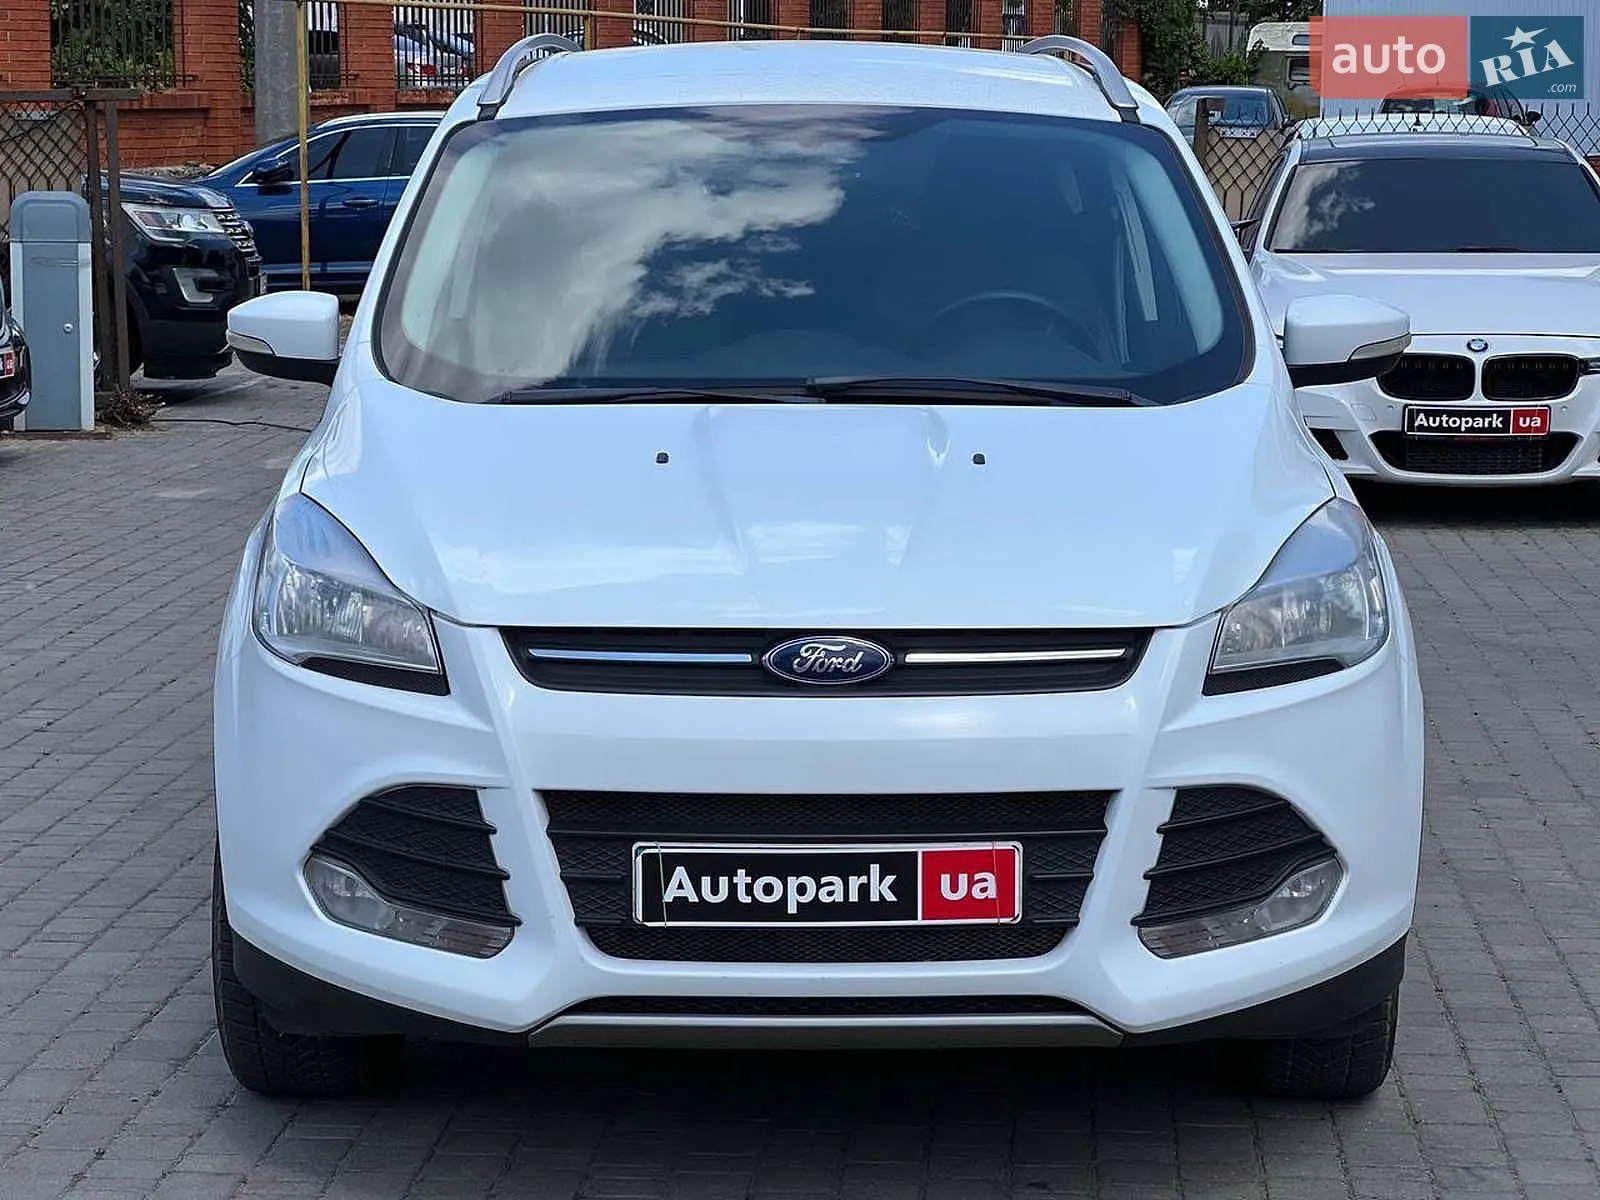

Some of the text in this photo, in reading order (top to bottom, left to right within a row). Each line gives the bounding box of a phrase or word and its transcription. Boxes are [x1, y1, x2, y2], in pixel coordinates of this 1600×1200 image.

[1415, 413, 1541, 431] Autopark ua
[792, 643, 864, 673] Ford
[663, 864, 998, 914] Autopark ua
